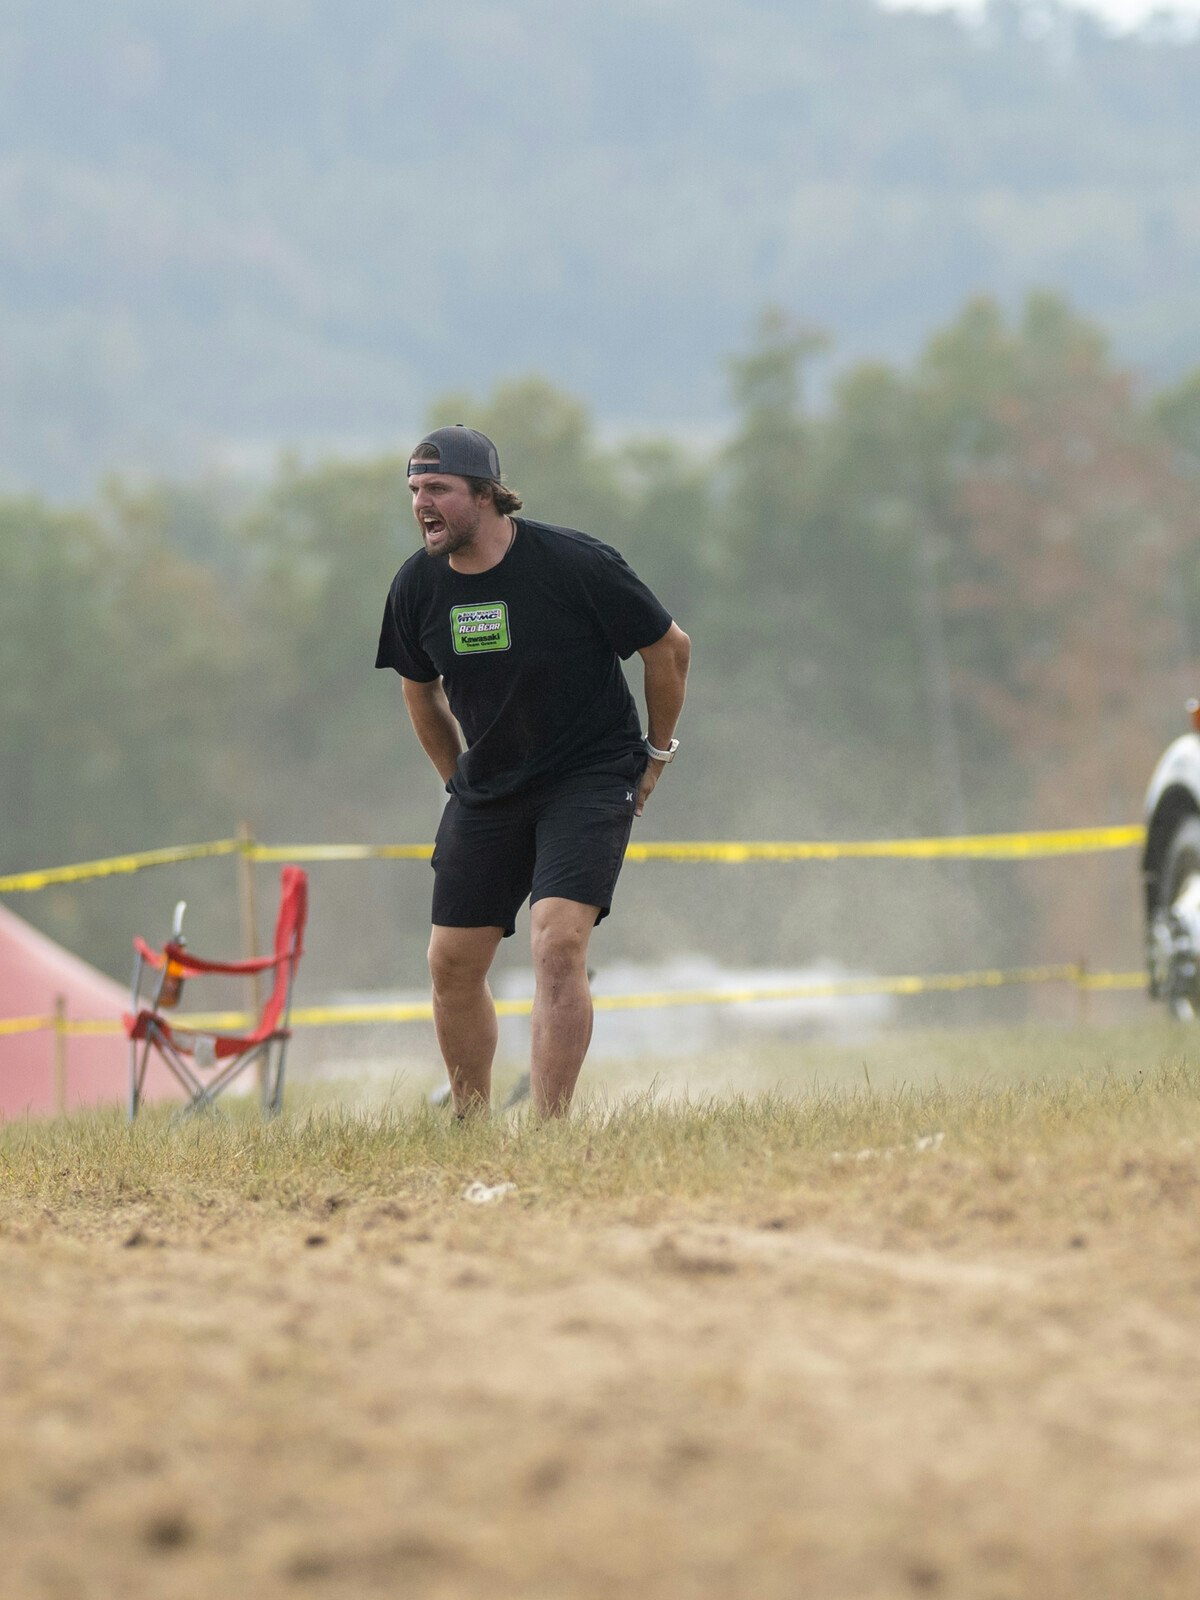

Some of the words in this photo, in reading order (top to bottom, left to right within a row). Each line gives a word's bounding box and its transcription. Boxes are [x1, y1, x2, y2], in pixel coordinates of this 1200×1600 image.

[459, 625, 476, 634] RED
[477, 623, 500, 632] BEAR
[461, 633, 500, 644] Kawasaki
